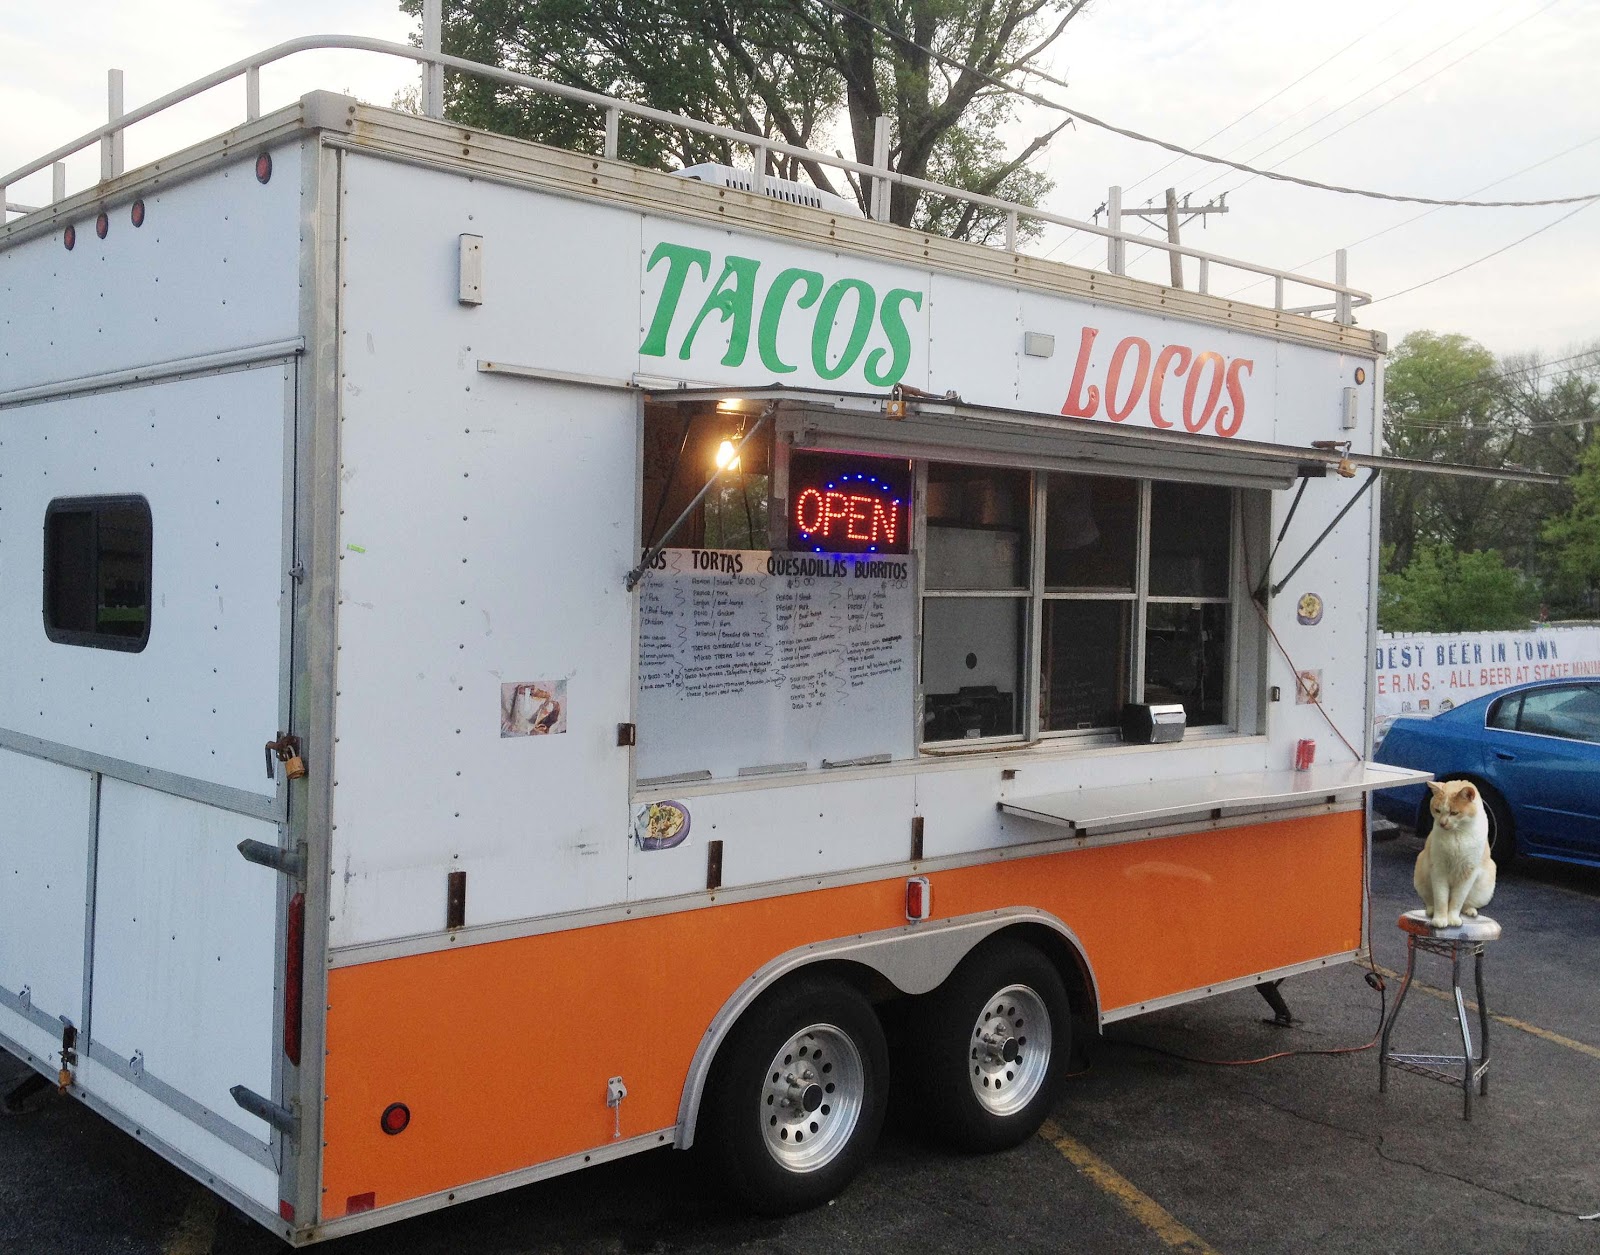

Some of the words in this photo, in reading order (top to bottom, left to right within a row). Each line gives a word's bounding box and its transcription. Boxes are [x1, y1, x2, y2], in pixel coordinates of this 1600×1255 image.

[638, 241, 923, 387] TACOS
[1061, 326, 1254, 437] LOCOS
[797, 488, 897, 543] OPEN
[691, 550, 743, 573] TORTAS
[766, 556, 847, 577] QUESADILLAS
[854, 560, 908, 579] BURRITOS
[1437, 641, 1483, 667] BEER
[1491, 640, 1506, 663] IN
[1514, 638, 1558, 662] TOWN
[1450, 671, 1475, 689] ALL
[1480, 668, 1512, 686] BEER
[1516, 665, 1530, 683] AT
[1534, 663, 1569, 681] STATE
